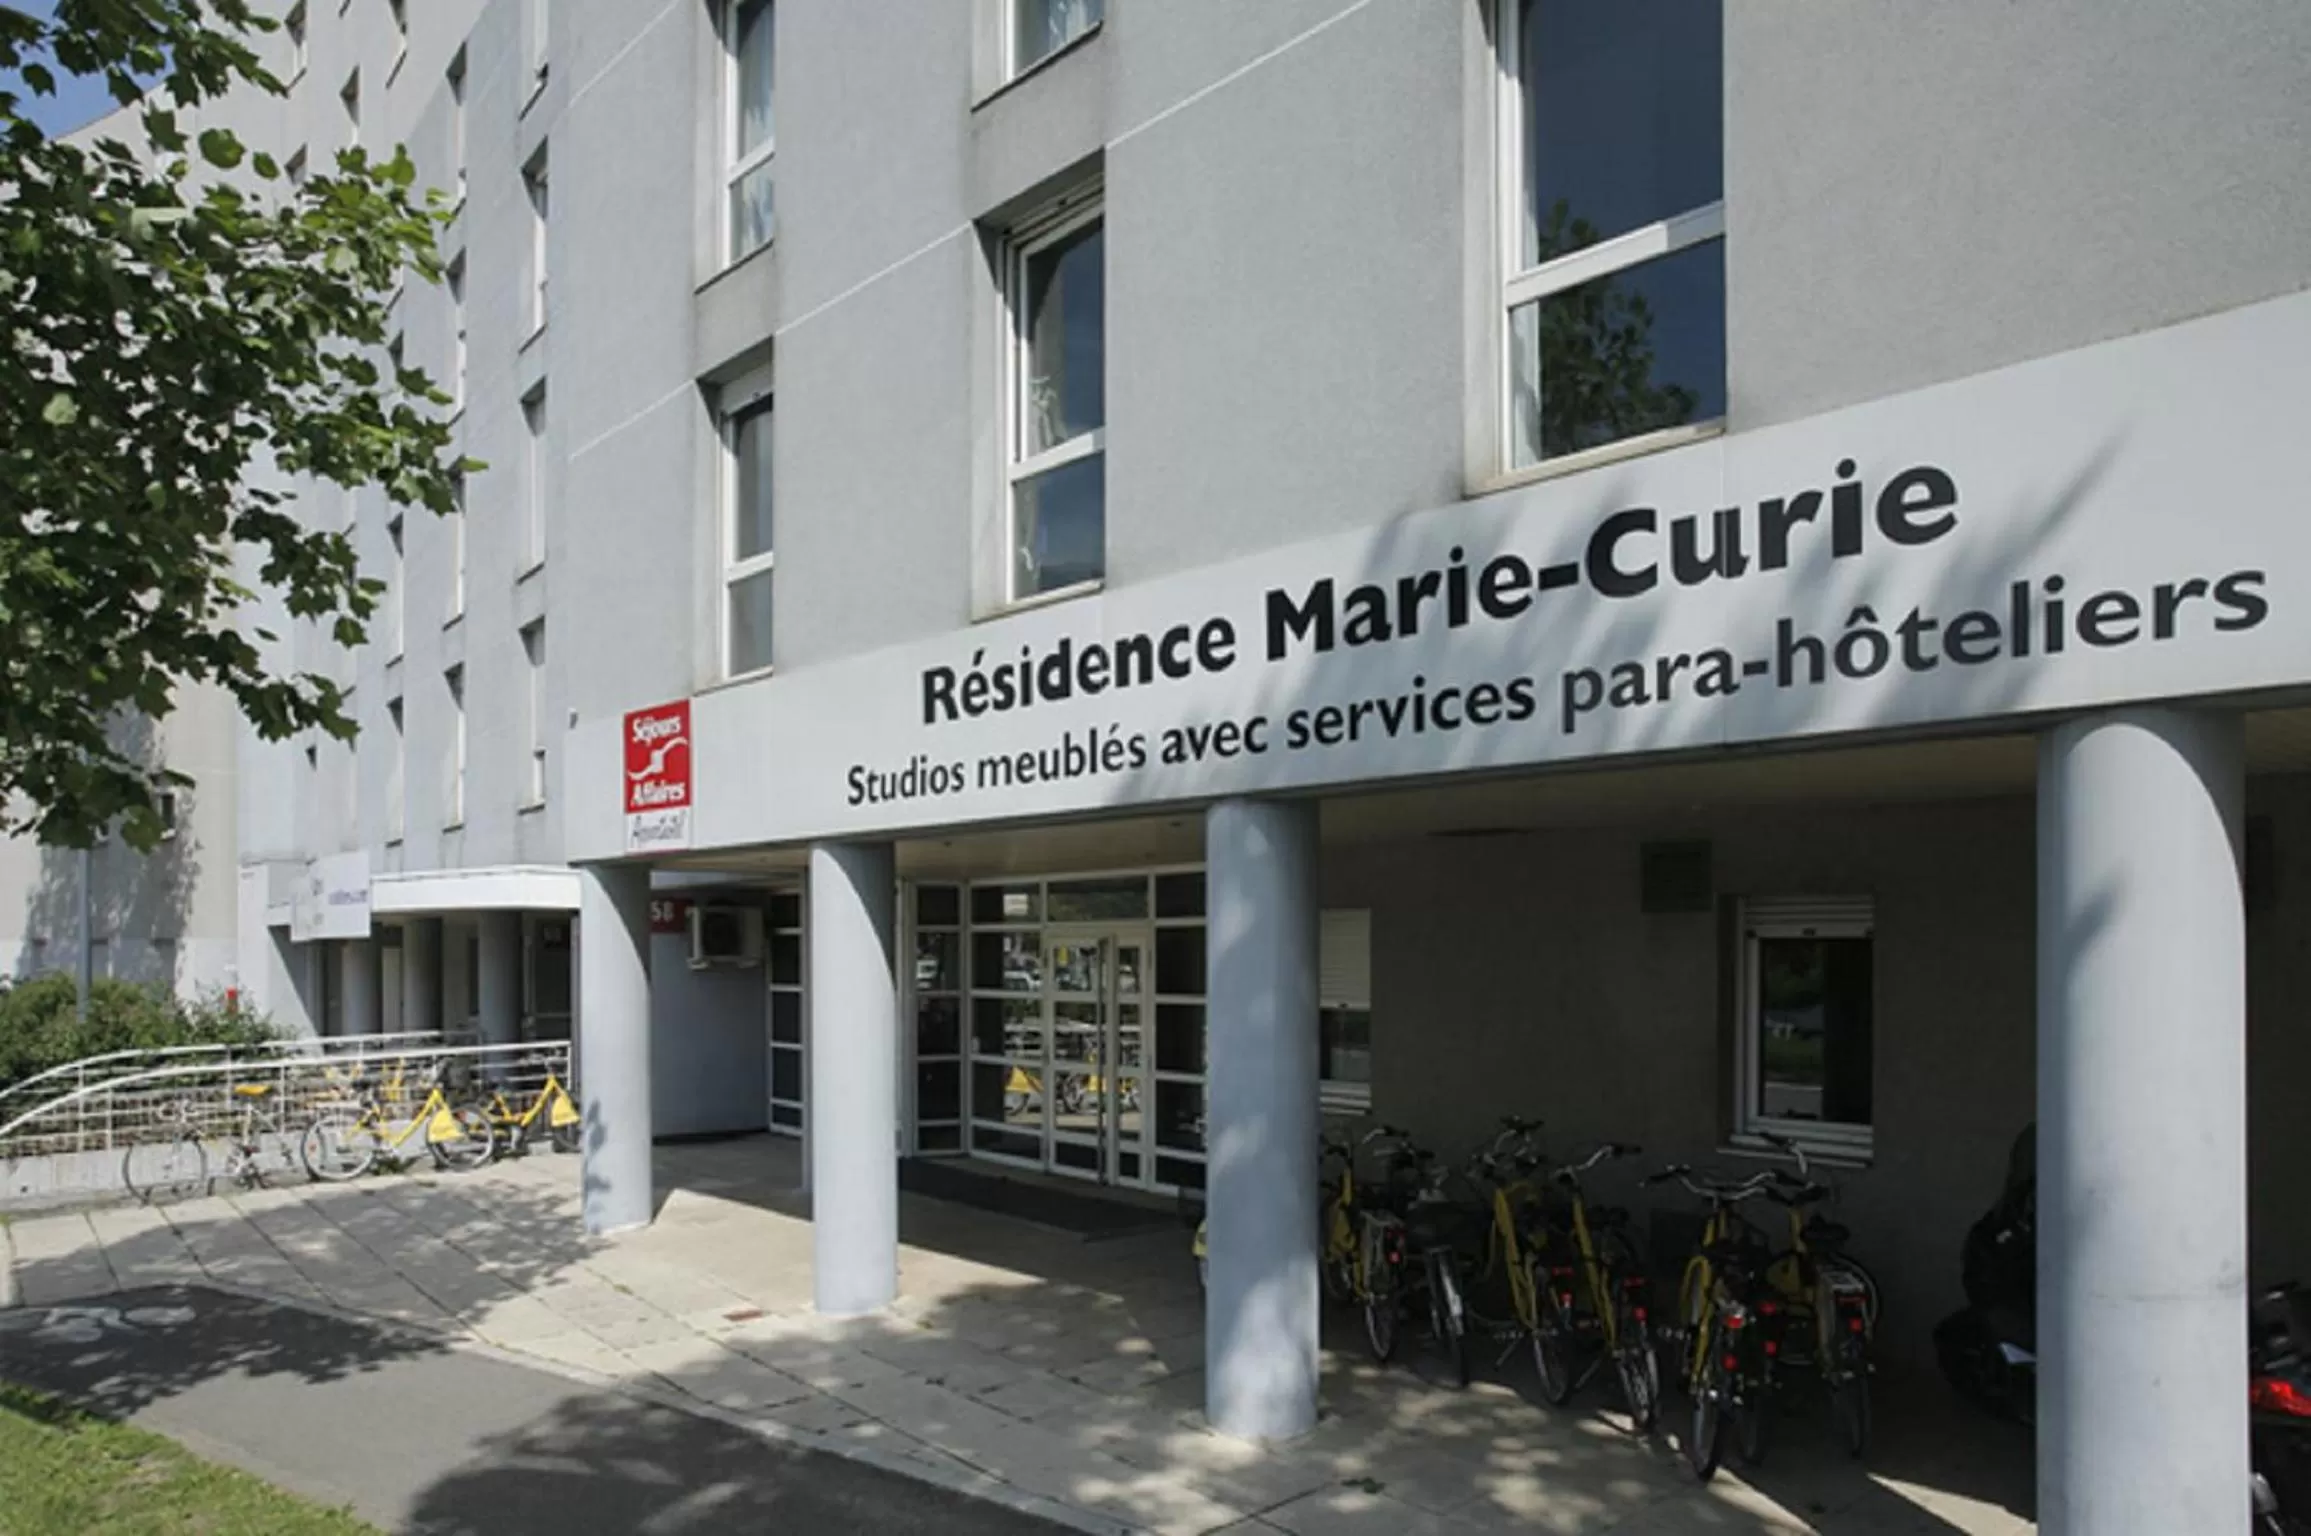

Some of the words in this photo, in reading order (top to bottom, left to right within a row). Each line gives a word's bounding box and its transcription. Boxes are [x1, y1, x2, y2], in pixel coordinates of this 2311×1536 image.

[847, 755, 965, 806] Studios
[978, 722, 1147, 788] meublés
[1161, 713, 1268, 763] avec
[1286, 674, 1535, 749] services
[1562, 569, 2270, 733] para-hôteliers
[921, 616, 1237, 725] Résidence
[1265, 459, 1958, 660] Marie-Curie
